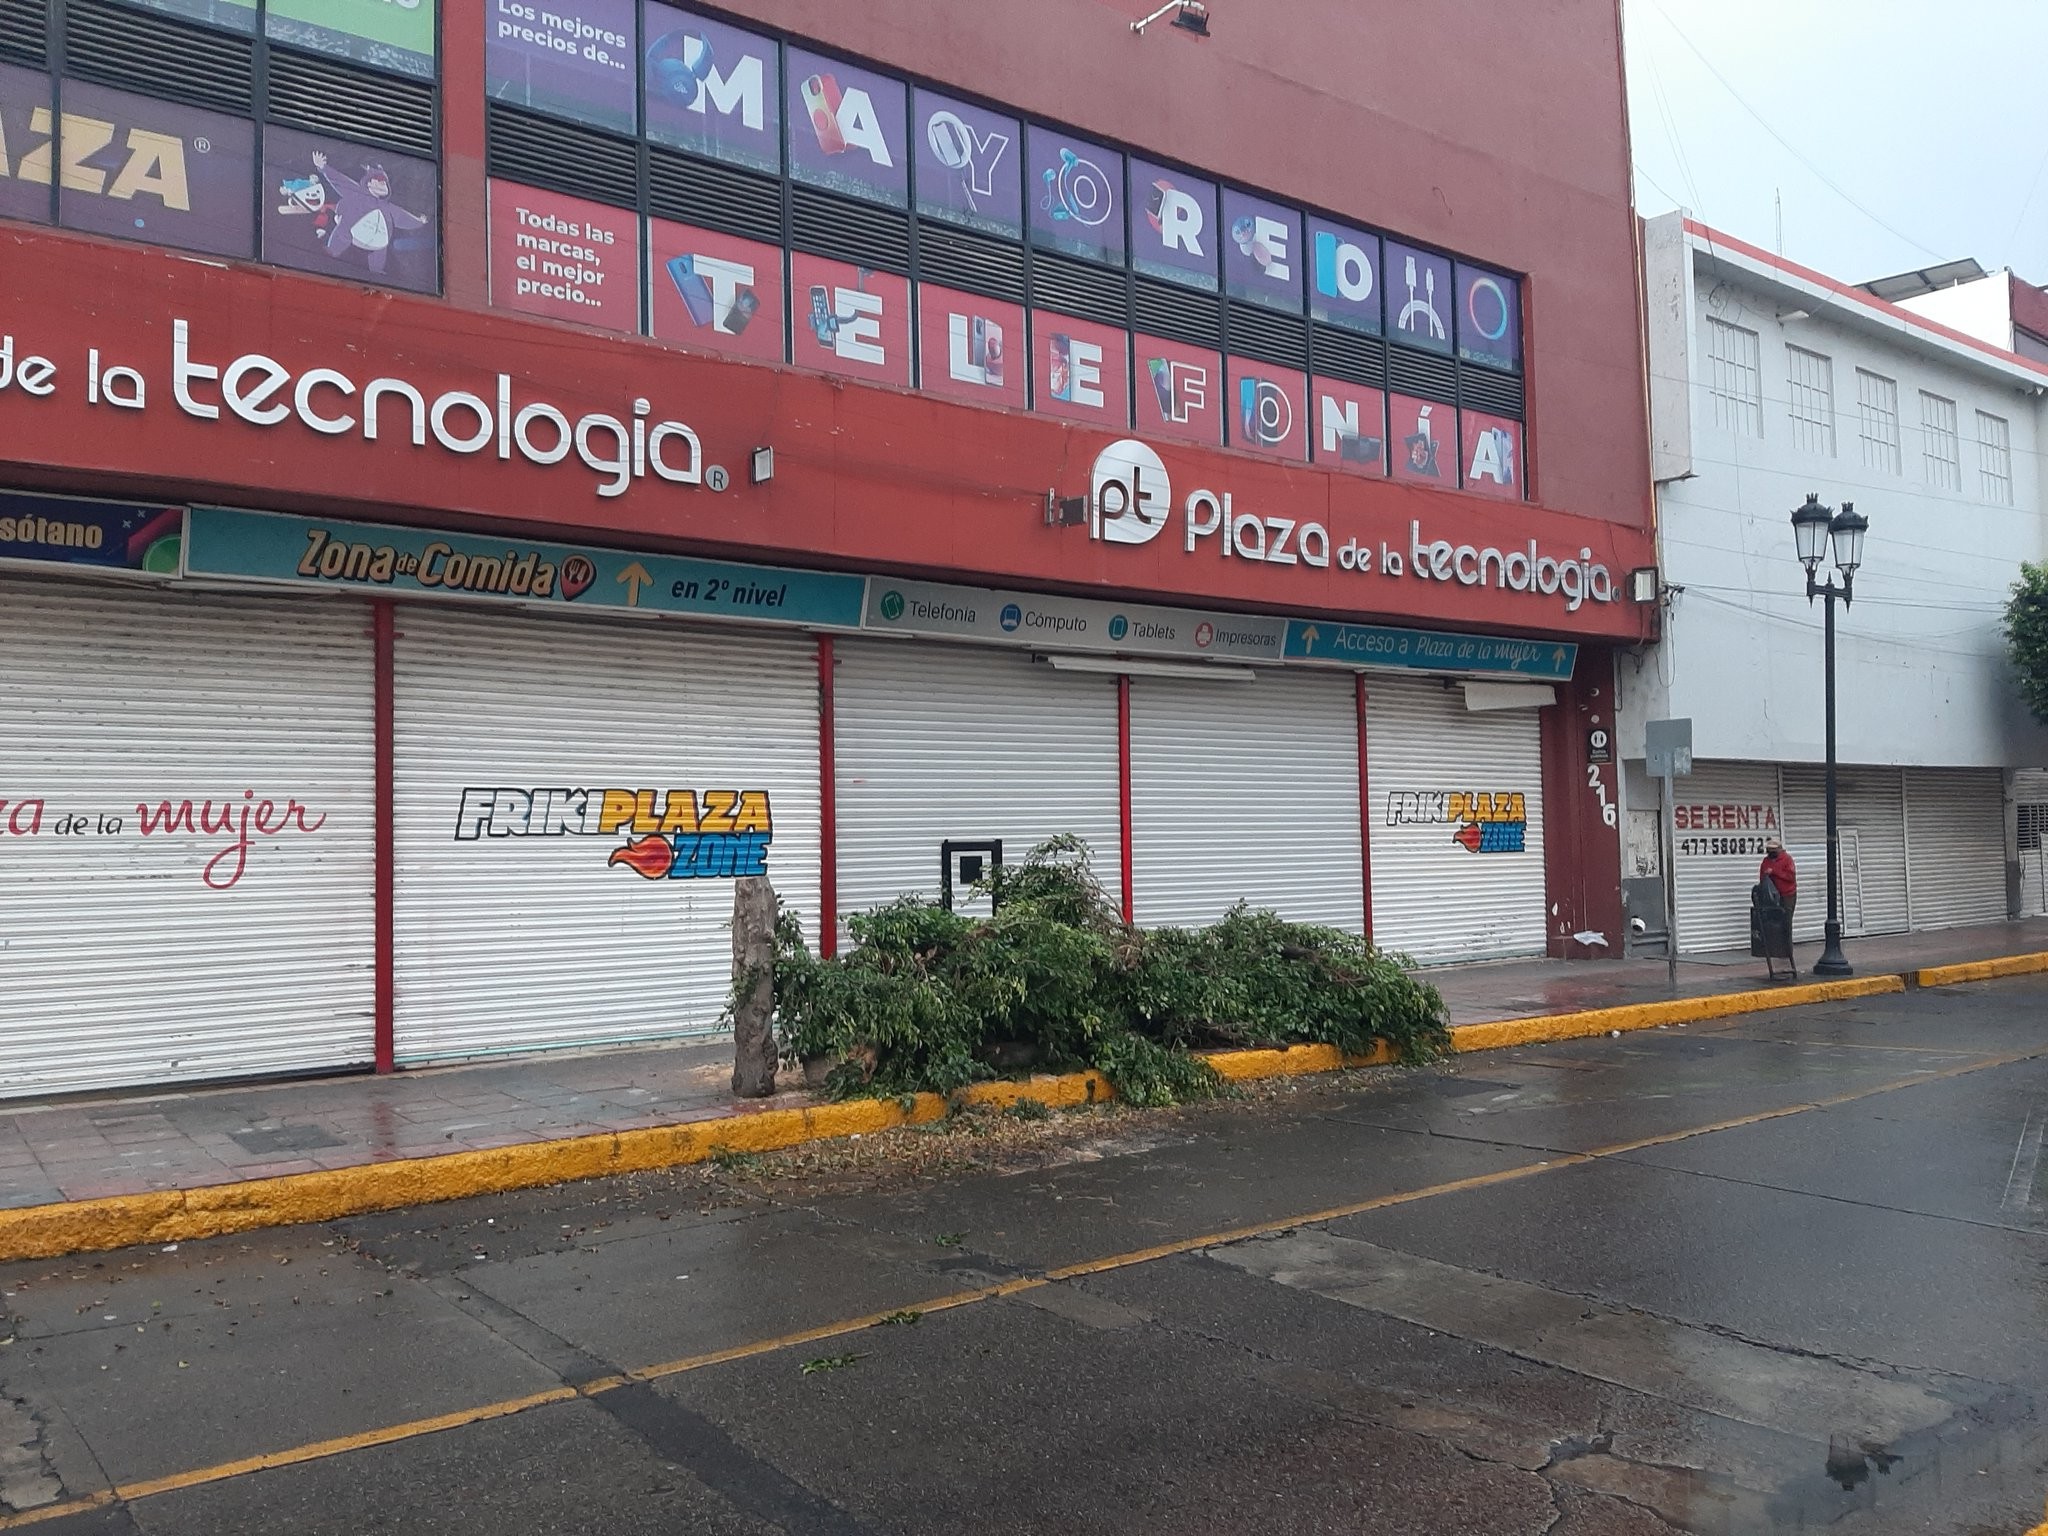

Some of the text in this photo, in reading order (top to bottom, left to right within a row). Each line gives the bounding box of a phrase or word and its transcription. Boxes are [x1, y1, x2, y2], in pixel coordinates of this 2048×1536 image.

[498, 0, 627, 49] Los mejores
[498, 20, 626, 70] precios de...
[516, 207, 615, 245] Todas las
[516, 232, 601, 266] marcas,
[516, 254, 605, 285] el mejor
[517, 277, 602, 307] precio...
[0, 335, 57, 395] de
[88, 348, 146, 409] la
[173, 319, 702, 497] tecnologia
[0, 513, 104, 549] sótano
[1185, 488, 1612, 612] Plaza de la tecnologia
[297, 529, 397, 583] Zona
[397, 552, 418, 575] de
[416, 542, 557, 598] Comida
[671, 580, 698, 599] en
[732, 581, 786, 607] nivel
[1025, 610, 1088, 633] Cómputo
[1132, 622, 1176, 640] Tablets
[1215, 628, 1277, 647] Impresoras
[1333, 626, 1395, 653] Acceso
[1398, 637, 1408, 655] a
[1415, 636, 1454, 657] Plaza
[1457, 641, 1474, 659] de
[1478, 642, 1491, 660] la
[54, 813, 89, 836] de
[96, 813, 123, 835] la
[136, 788, 327, 890] mujer
[668, 832, 773, 879] ZONE
